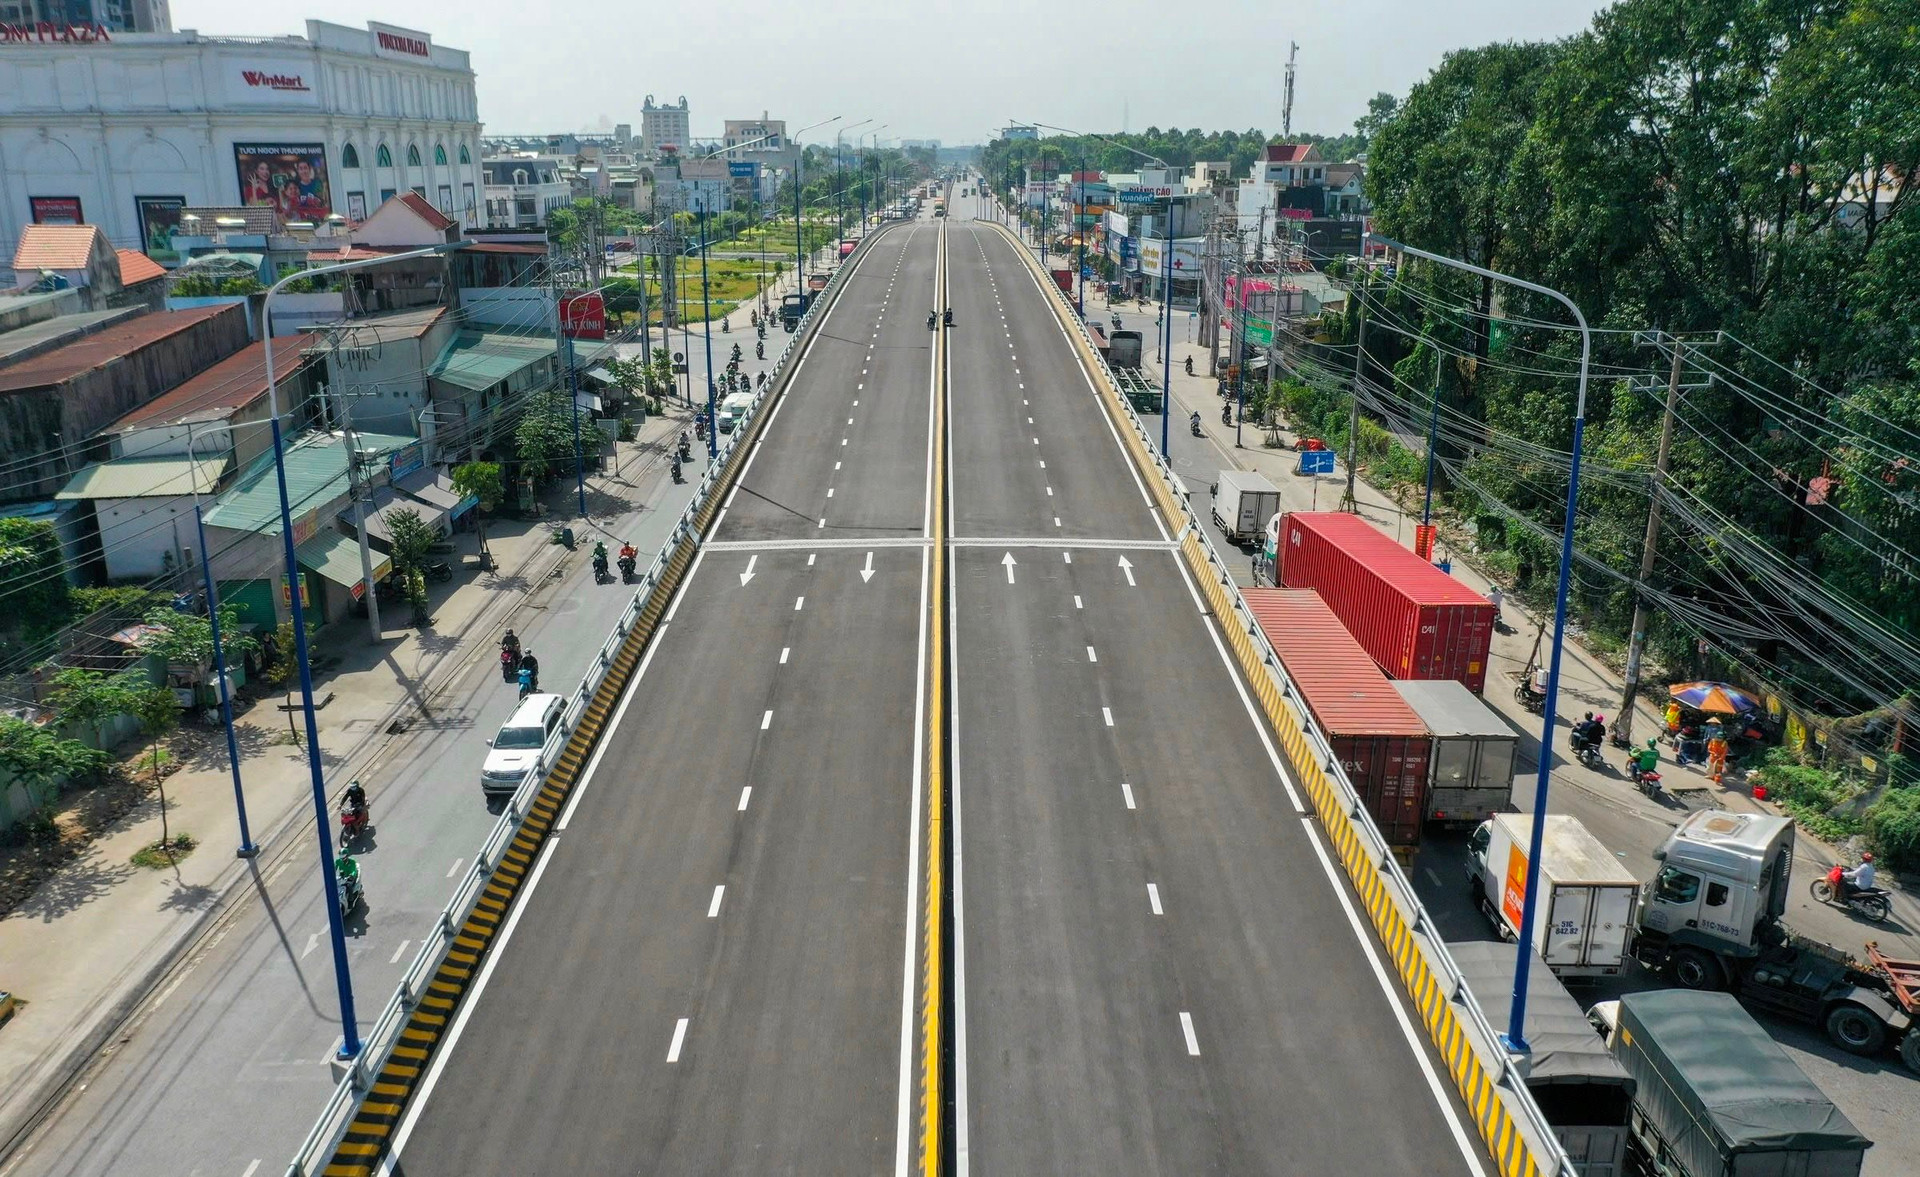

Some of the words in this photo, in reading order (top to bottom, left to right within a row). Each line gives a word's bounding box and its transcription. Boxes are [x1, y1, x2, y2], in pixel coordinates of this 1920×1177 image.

[36, 21, 110, 42] PLAZA
[241, 71, 302, 86] WinMart
[1421, 625, 1435, 634] CAI
[1555, 927, 1579, 935] 842.82
